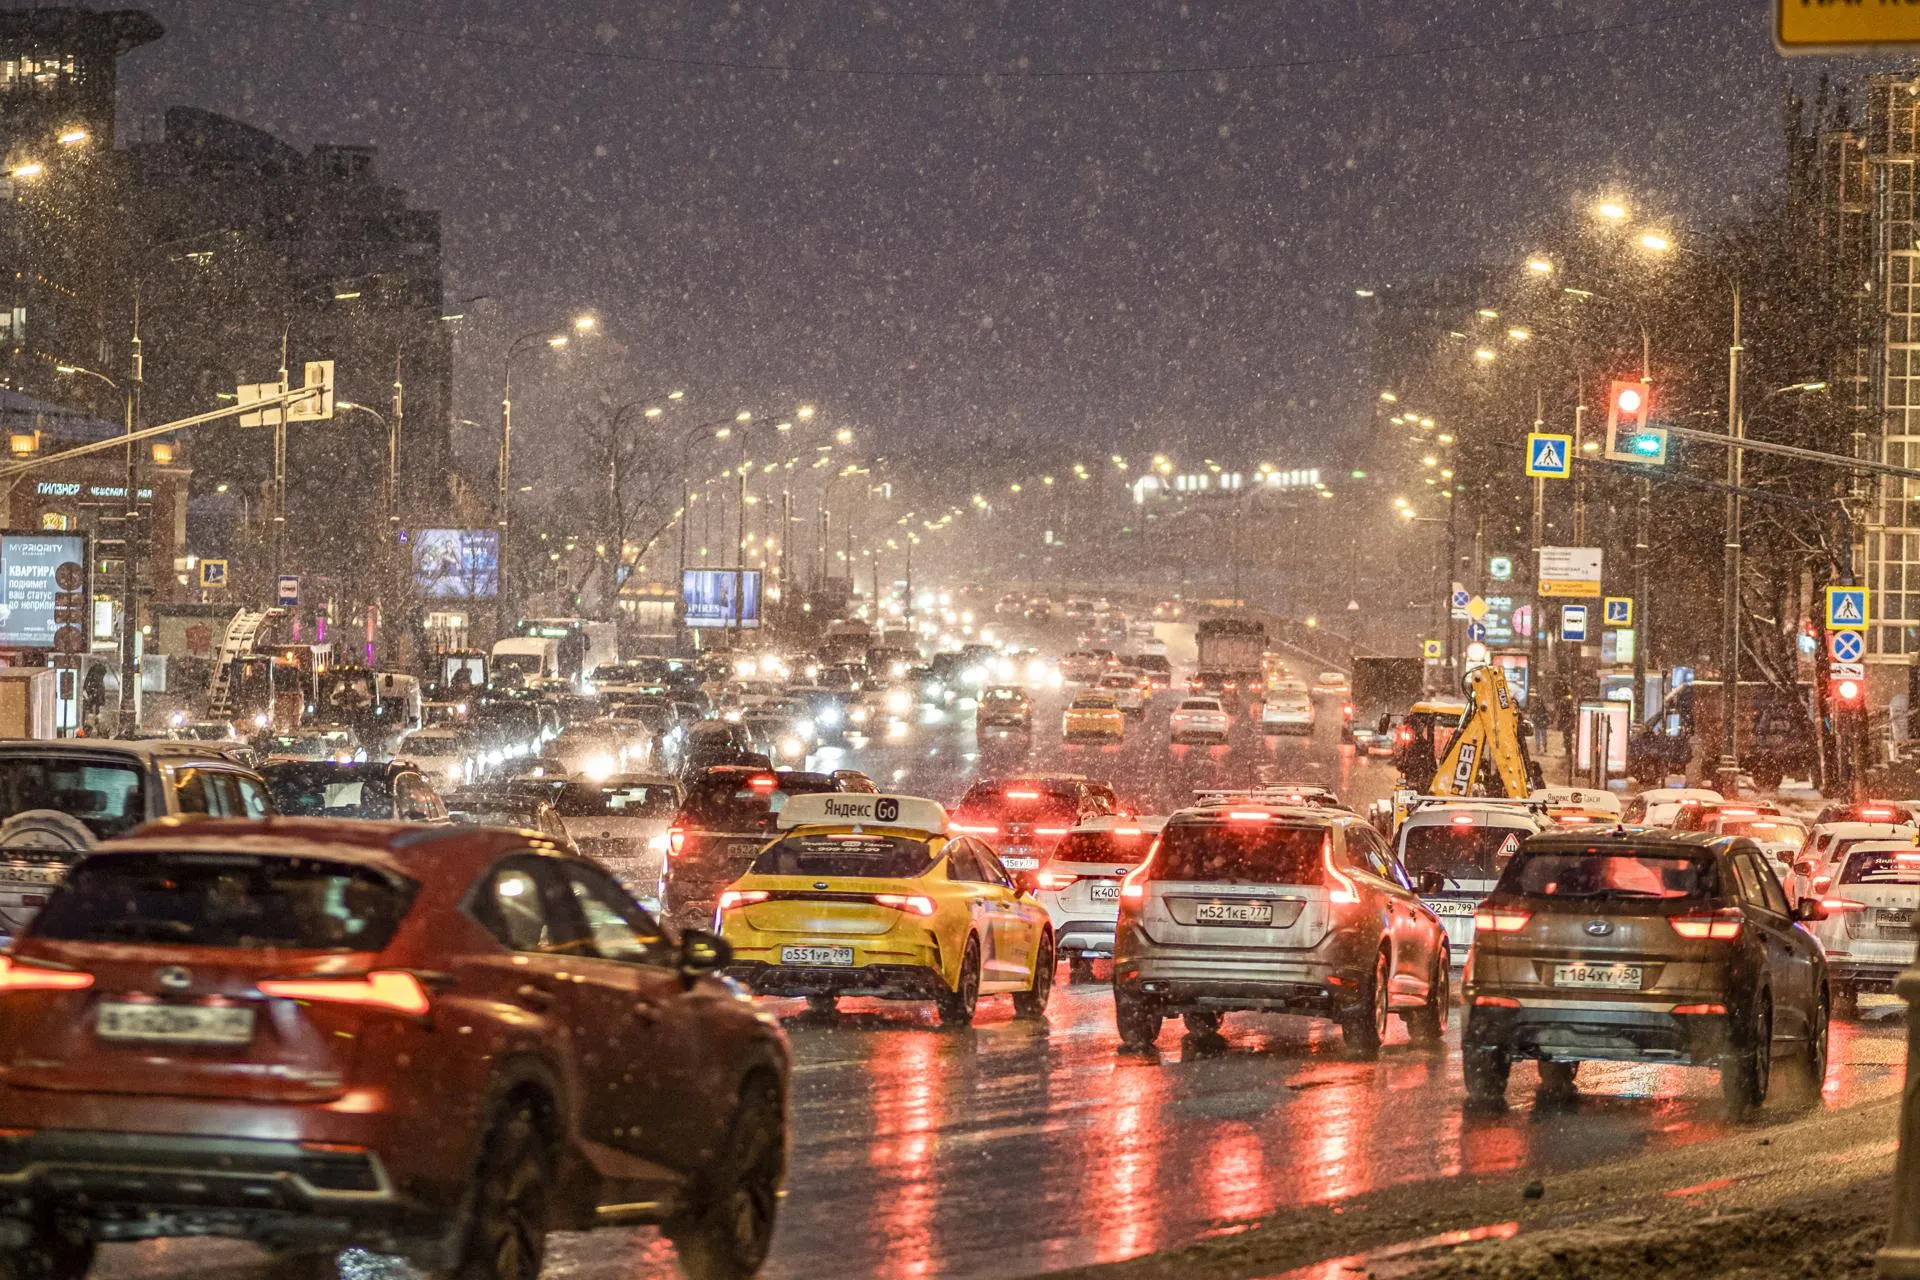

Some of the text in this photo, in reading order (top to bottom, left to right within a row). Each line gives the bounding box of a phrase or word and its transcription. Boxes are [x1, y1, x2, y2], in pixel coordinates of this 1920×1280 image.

[9, 565, 55, 577] КВАРТИРА
[9, 580, 47, 589] поднимет
[9, 591, 52, 603] ваш статус
[9, 601, 19, 610] до
[1452, 744, 1476, 796] JCB
[1547, 793, 1569, 802] Яндекс
[824, 798, 897, 819] Яндекс Go
[1506, 844, 1516, 853] Ш
[1250, 906, 1269, 916] 777
[833, 949, 850, 958] 799
